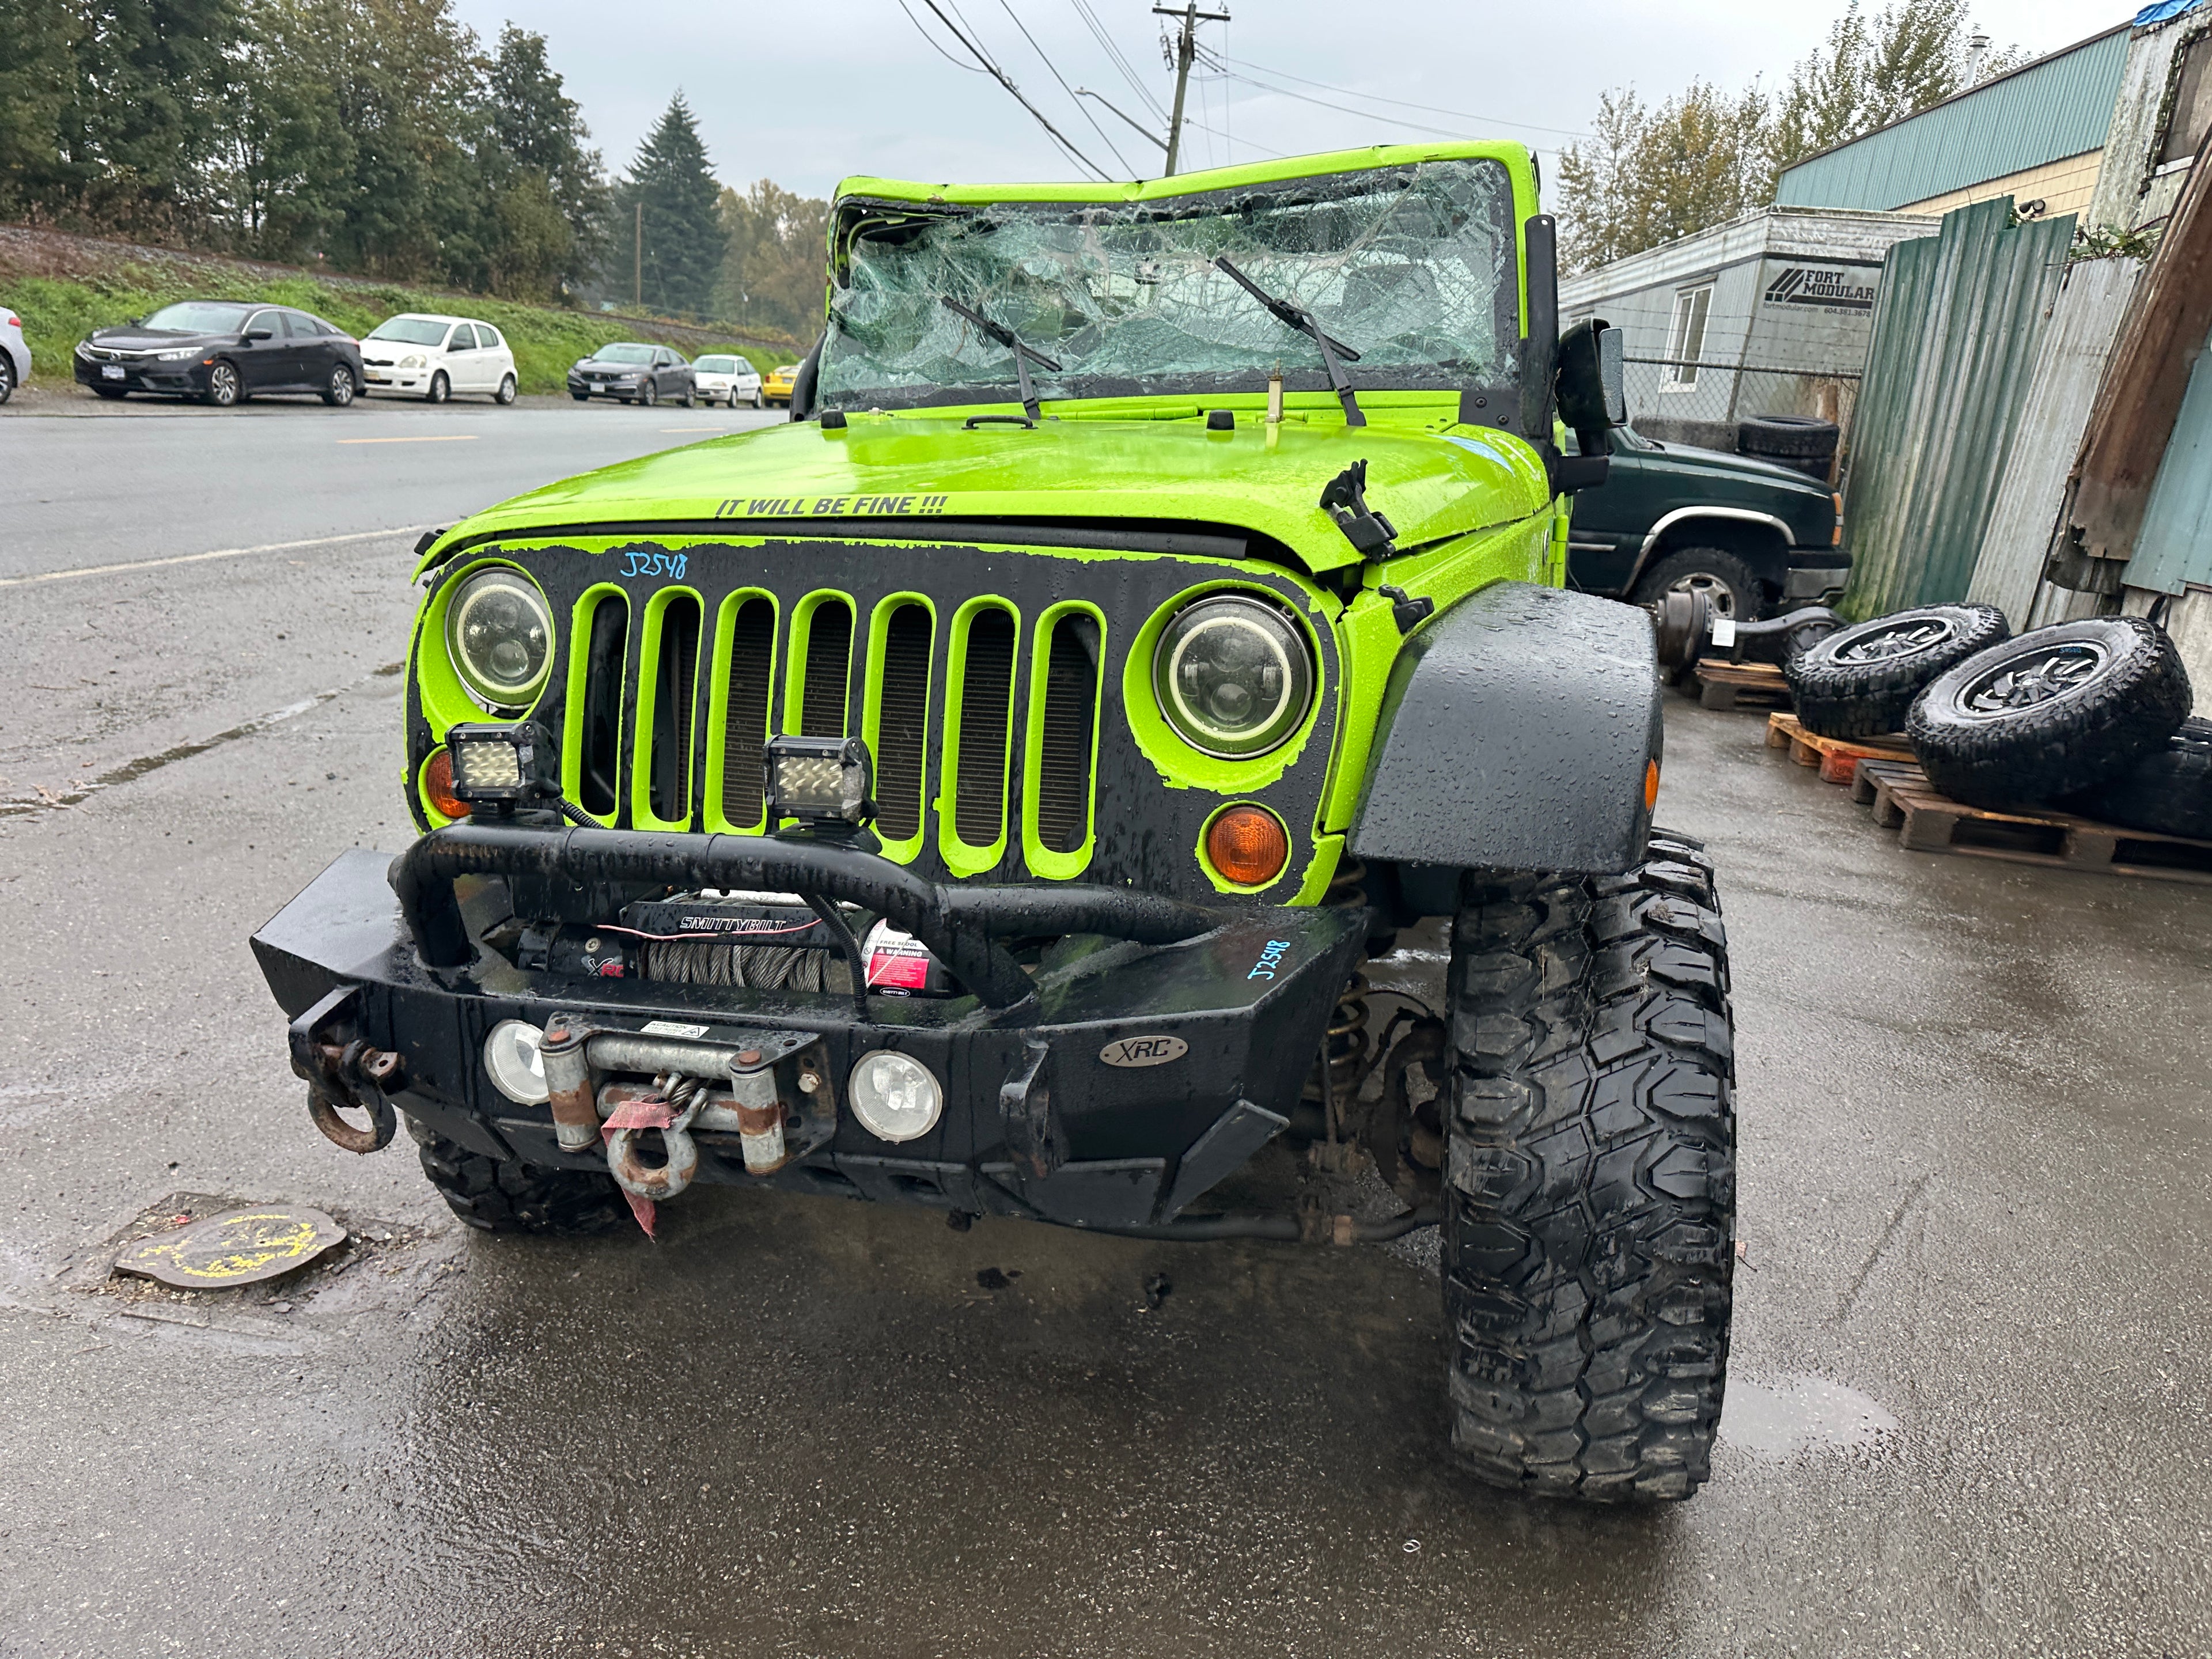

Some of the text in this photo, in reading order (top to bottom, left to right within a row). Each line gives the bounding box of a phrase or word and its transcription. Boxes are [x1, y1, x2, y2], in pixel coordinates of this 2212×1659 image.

[1805, 270, 1845, 284] FORT
[1802, 282, 1875, 300] MODULAR
[1763, 302, 1819, 313] fortmodular.com
[715, 499, 745, 516] IT
[747, 499, 805, 516] WILL
[812, 498, 851, 514] BE
[852, 497, 916, 514] FINE
[620, 552, 688, 579] J2548
[679, 916, 787, 931] SMITTYBILT
[886, 948, 923, 957] WARNING
[1247, 940, 1291, 980] J2548
[1115, 1039, 1171, 1063] XRC
